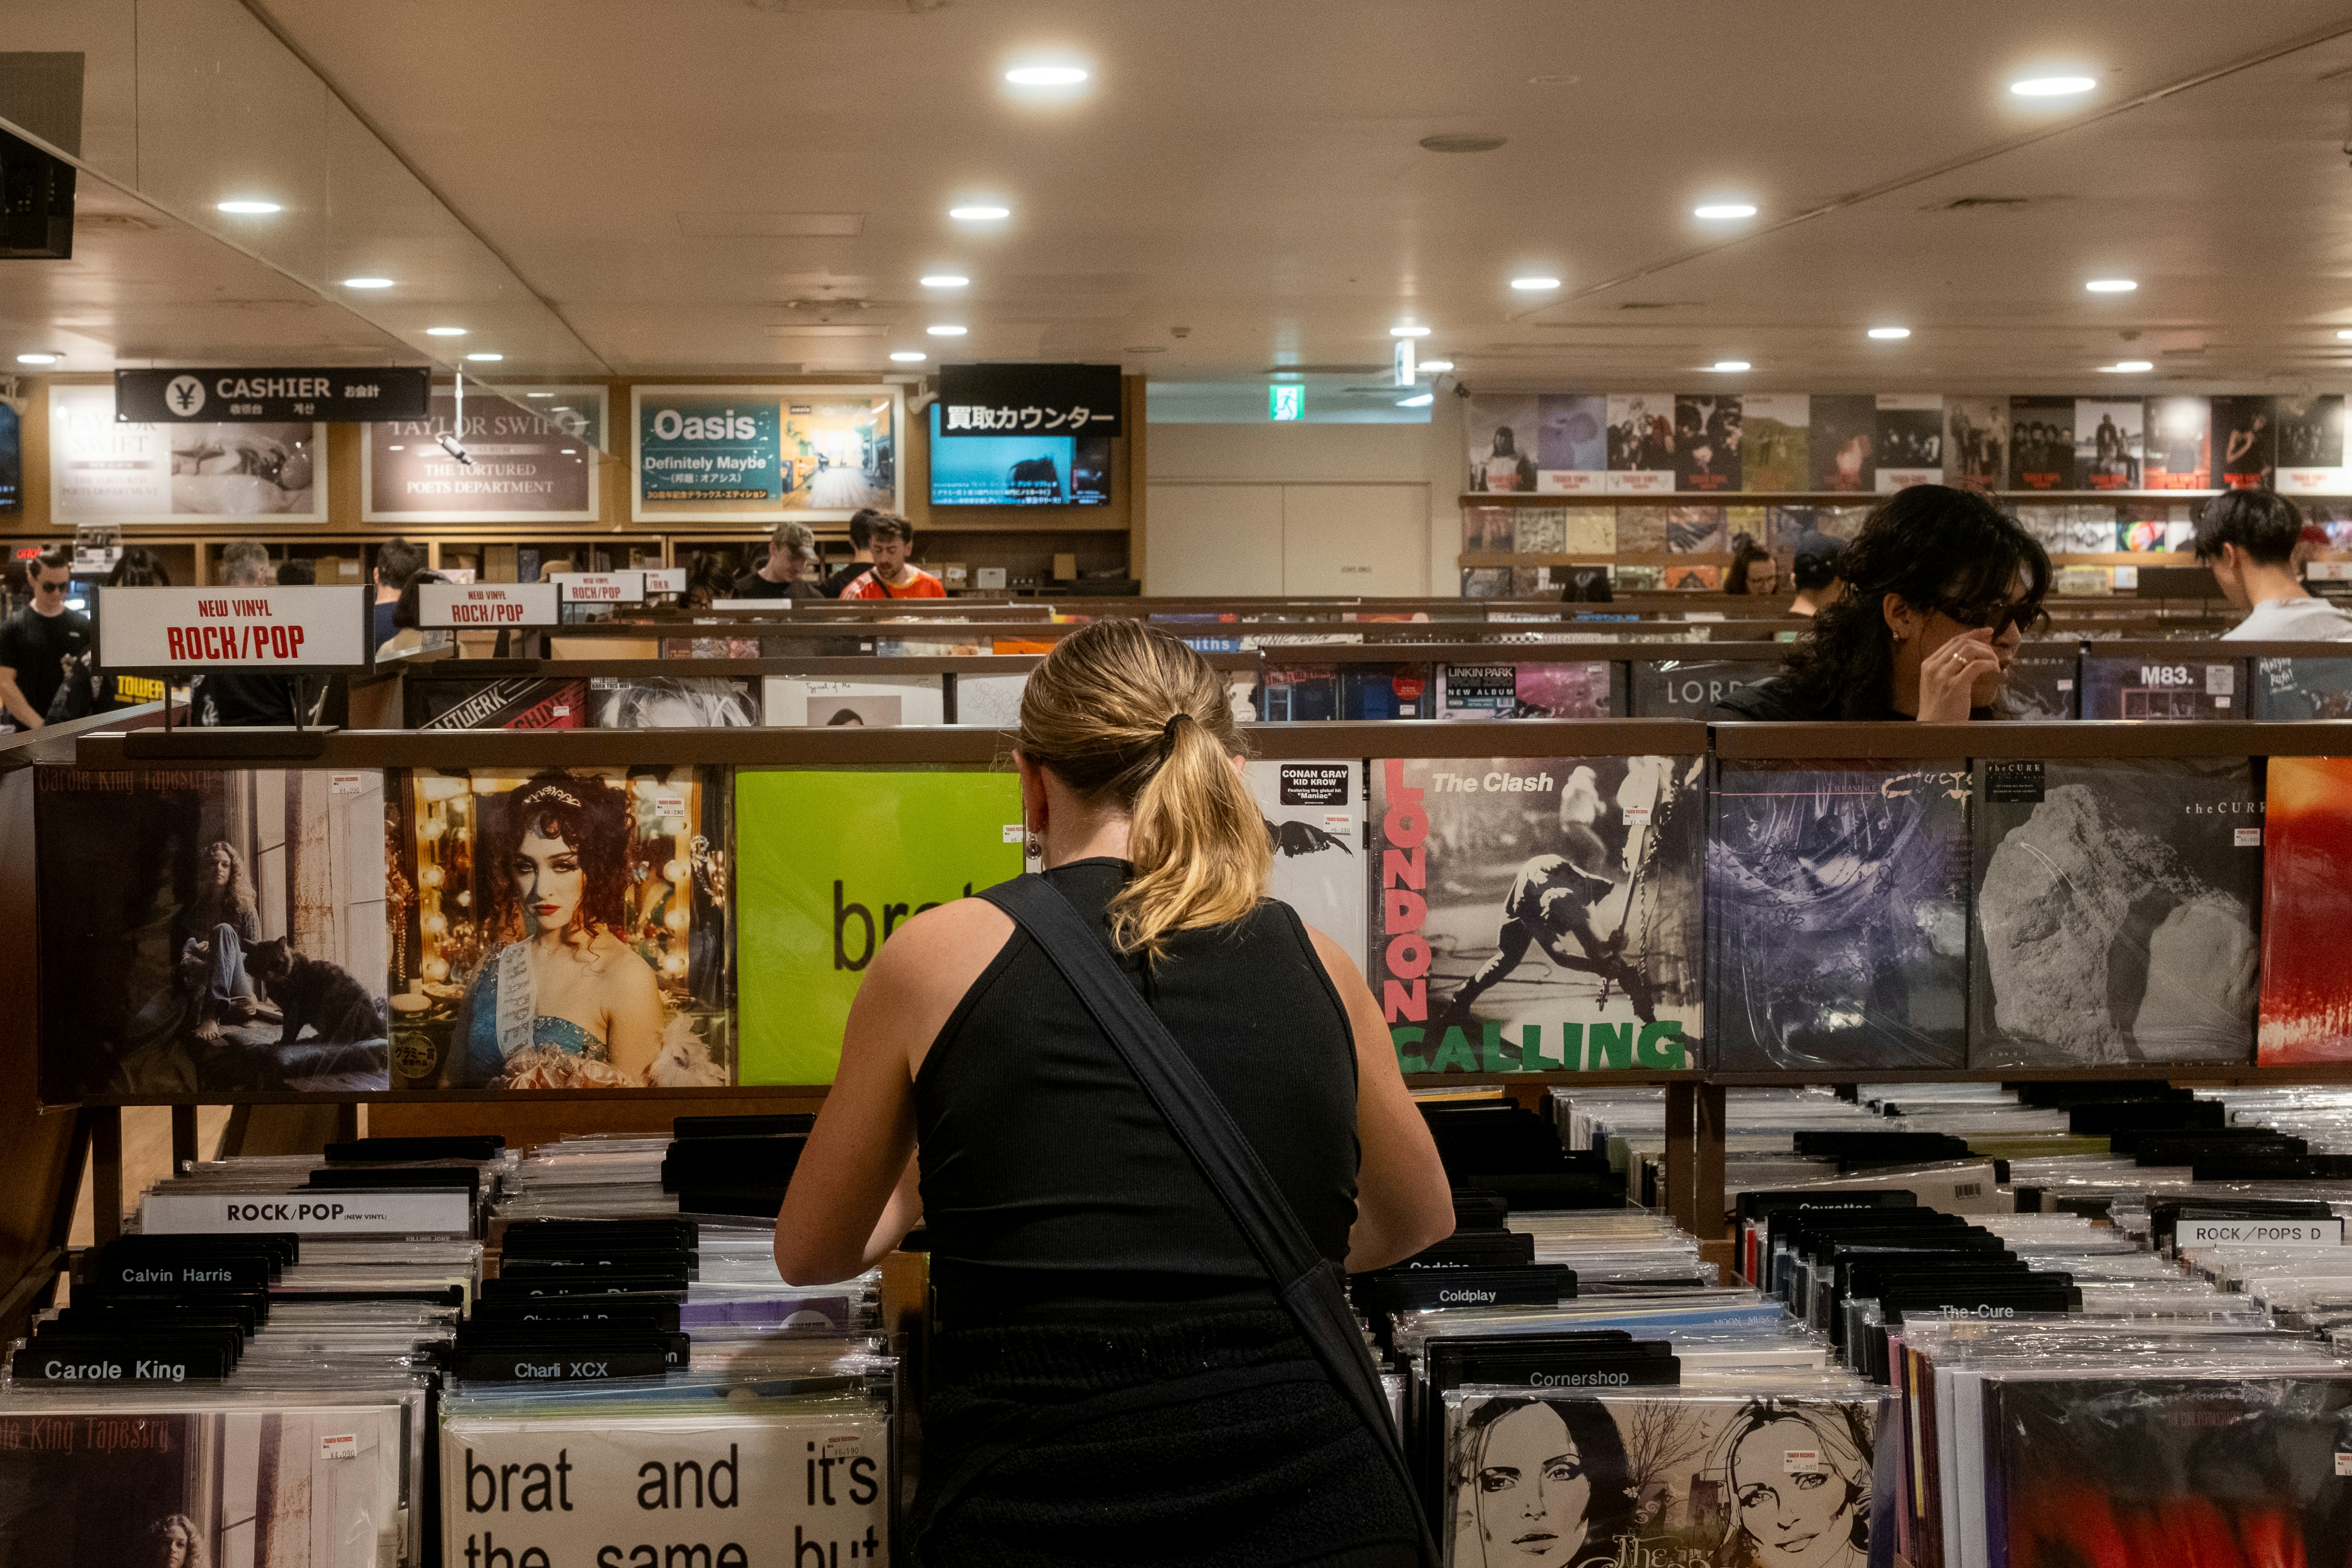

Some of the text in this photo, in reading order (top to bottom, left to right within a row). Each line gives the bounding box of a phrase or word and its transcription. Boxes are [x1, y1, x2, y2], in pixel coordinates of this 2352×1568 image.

[216, 378, 331, 398] CASHIER
[654, 409, 756, 441] Oasis
[947, 405, 1115, 429] 買取カウンター
[423, 464, 537, 477] THE TORTURED
[644, 456, 767, 473] Definitely Maybe
[406, 481, 554, 493] POETS DEPARTMENT
[468, 590, 507, 601] NEW VINYL
[572, 587, 621, 599] ROCK/POP
[198, 599, 273, 617] NEW VINYL
[451, 604, 524, 622] ROCK/POP
[167, 625, 305, 660] ROCK/POP
[1448, 667, 1513, 678] LINKIN PARK
[2141, 666, 2194, 685] M83.
[805, 683, 828, 694] Typical
[832, 683, 839, 692] of
[39, 766, 90, 792] Carole
[1282, 770, 1348, 778] CONAN GRAY
[1431, 772, 1553, 792] The Clash
[1383, 758, 1432, 1023] LONDON
[395, 1047, 435, 1061] グラミー賞
[1390, 1019, 1686, 1072] CALLING
[227, 1203, 345, 1222] ROCK/POP
[2310, 1227, 2322, 1240] D
[122, 1268, 233, 1283] Calvin Harris
[1440, 1289, 1497, 1303] Coldplay
[1939, 1303, 2015, 1319] The Cure
[1714, 1317, 1742, 1326] MOON
[44, 1359, 186, 1382] Carole King
[514, 1362, 609, 1378] Charli XCX
[1529, 1370, 1630, 1388] Cornershop
[30, 1417, 74, 1455] King
[84, 1416, 170, 1453] Tapestry
[329, 1450, 355, 1460] ¥4,090
[465, 1441, 879, 1512] brat and it's
